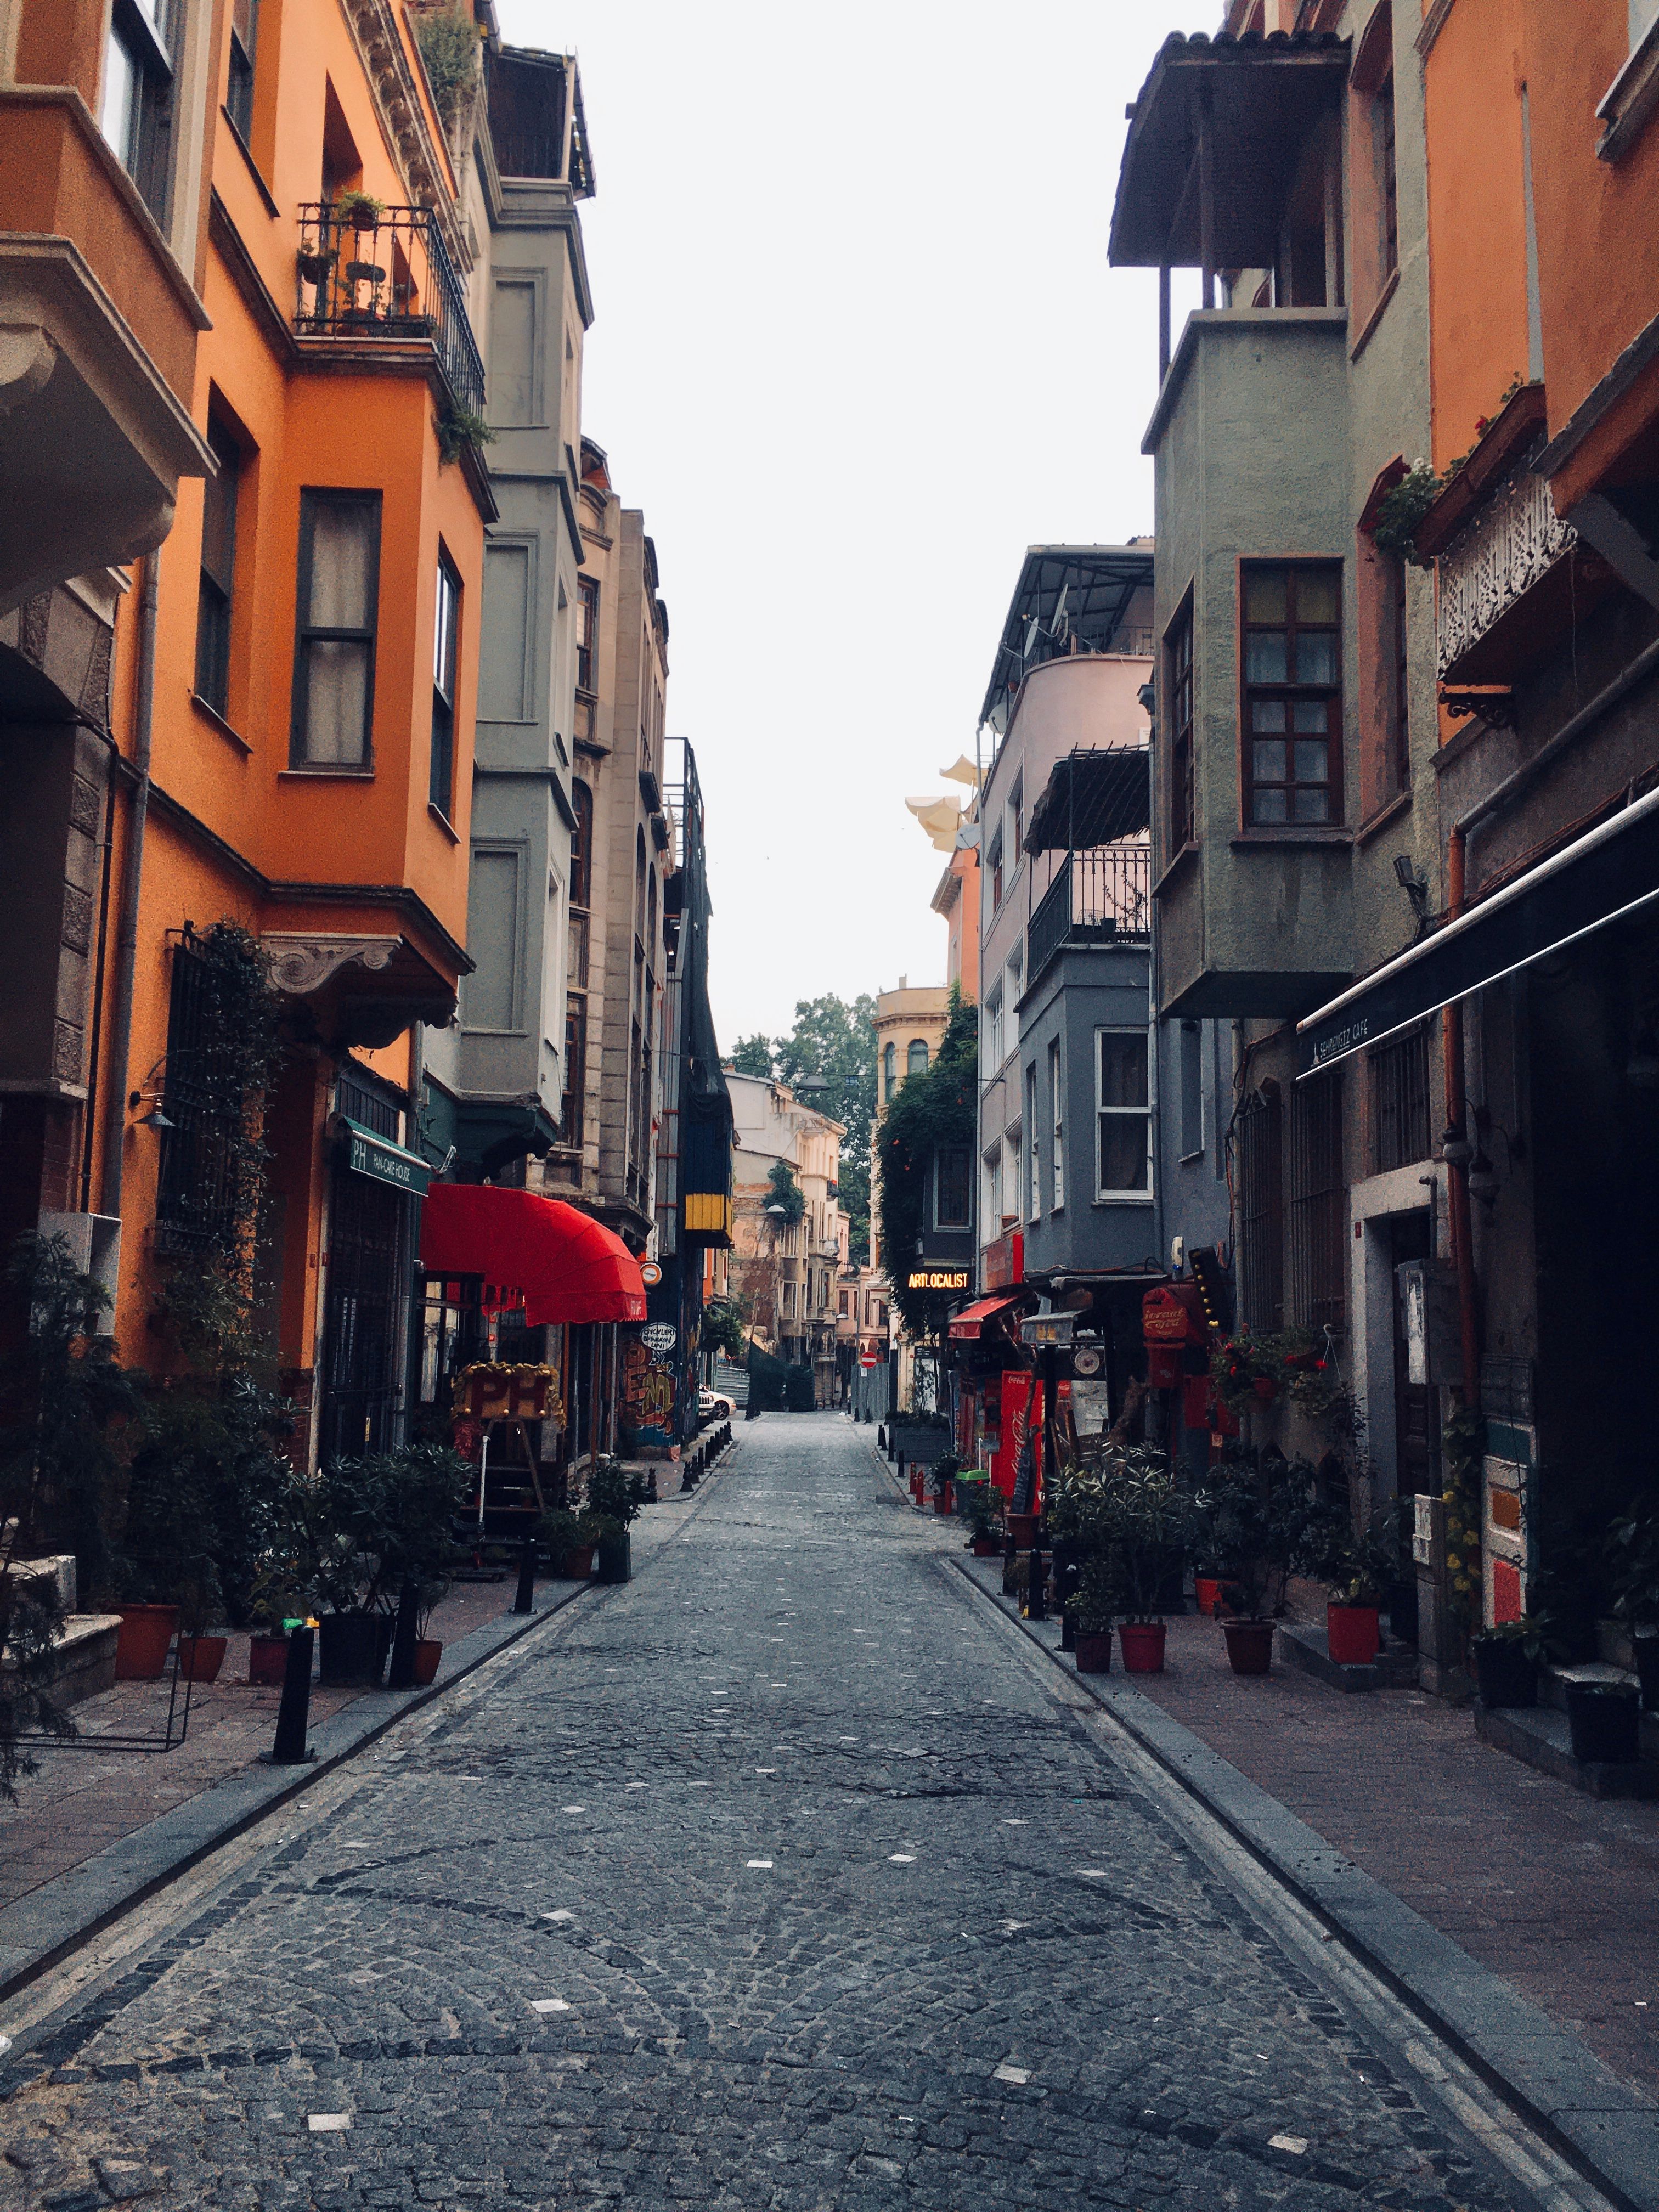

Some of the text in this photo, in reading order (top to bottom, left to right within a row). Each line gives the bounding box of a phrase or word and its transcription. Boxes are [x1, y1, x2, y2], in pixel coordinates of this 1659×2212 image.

[1353, 1018, 1368, 1040] CAFE
[354, 1139, 366, 1171] PH
[908, 1273, 968, 1288] ARTLOCALIST
[471, 1370, 551, 1419] PH
